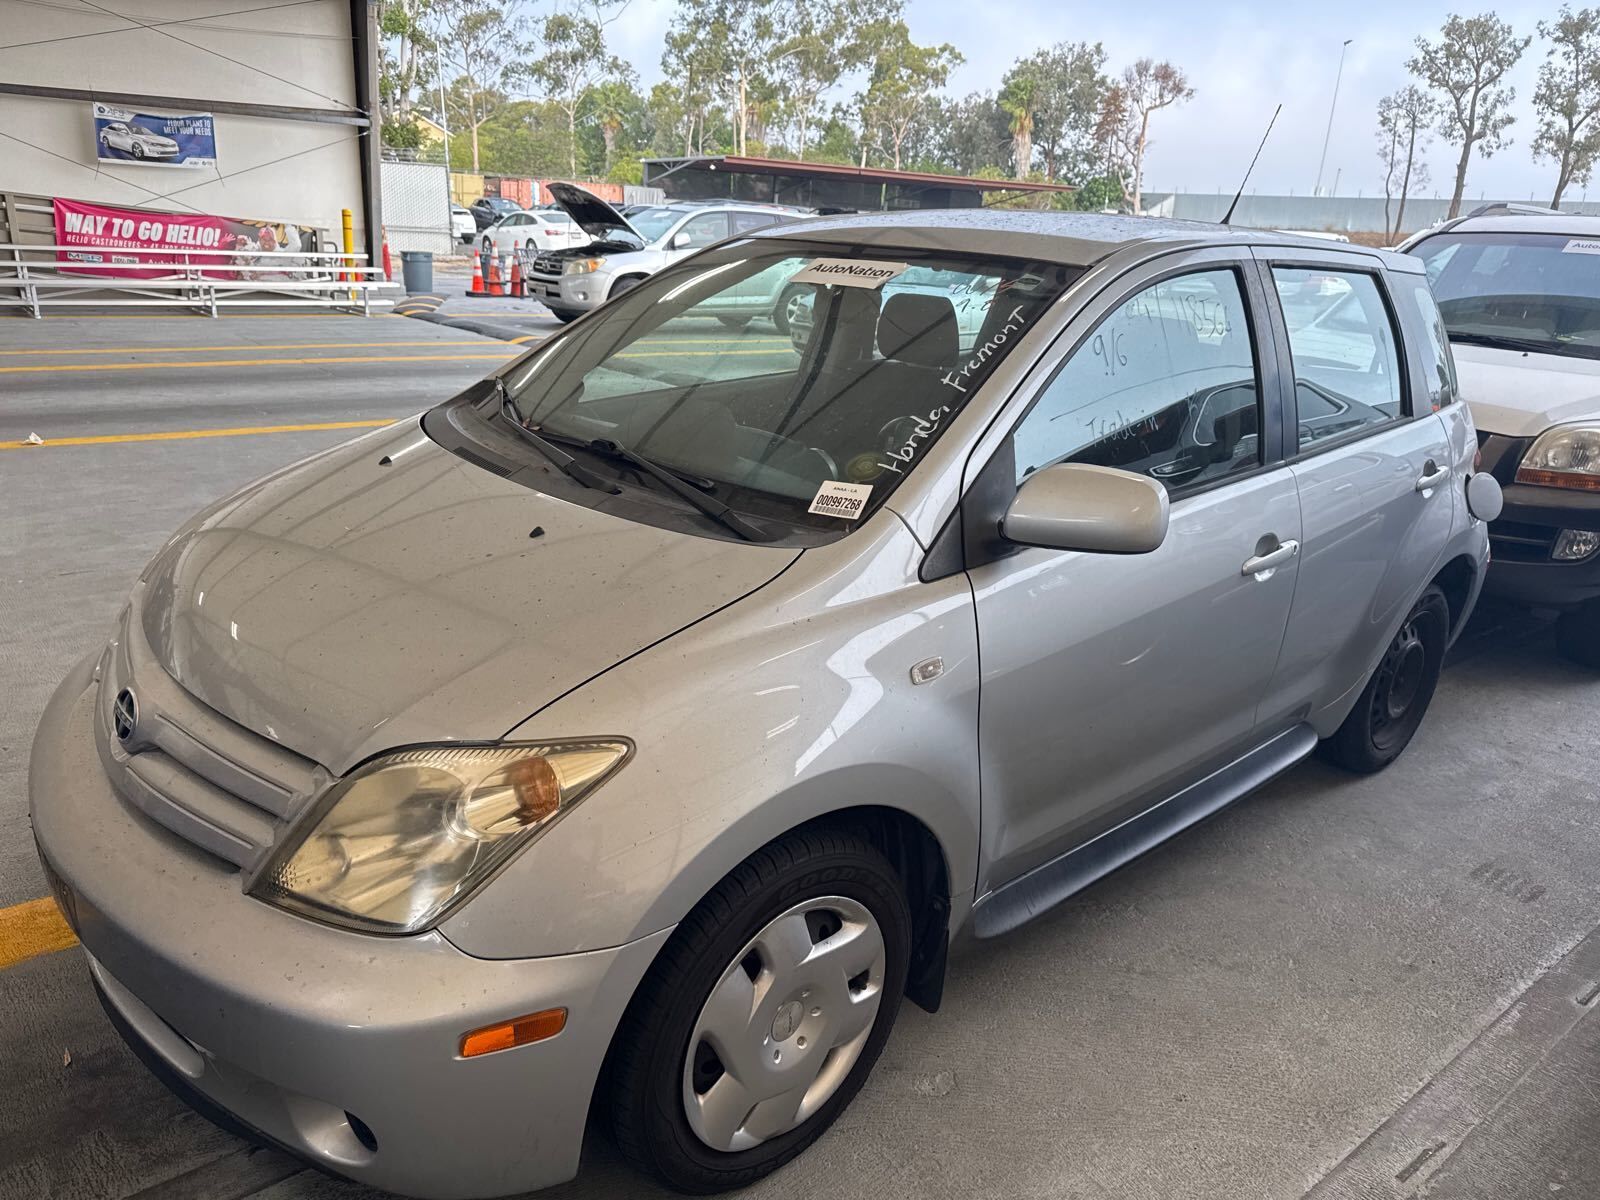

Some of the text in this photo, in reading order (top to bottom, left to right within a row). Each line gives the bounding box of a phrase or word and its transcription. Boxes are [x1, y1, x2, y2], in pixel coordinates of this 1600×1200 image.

[163, 126, 212, 136] MEET YOUR NEEDS
[204, 120, 211, 128] TO
[65, 213, 221, 247] WAY TO GO HELIO!
[66, 234, 88, 245] HELIO
[91, 236, 141, 249] CASTRONEVES
[810, 263, 895, 278] AutoNation
[816, 494, 863, 511] 000997268
